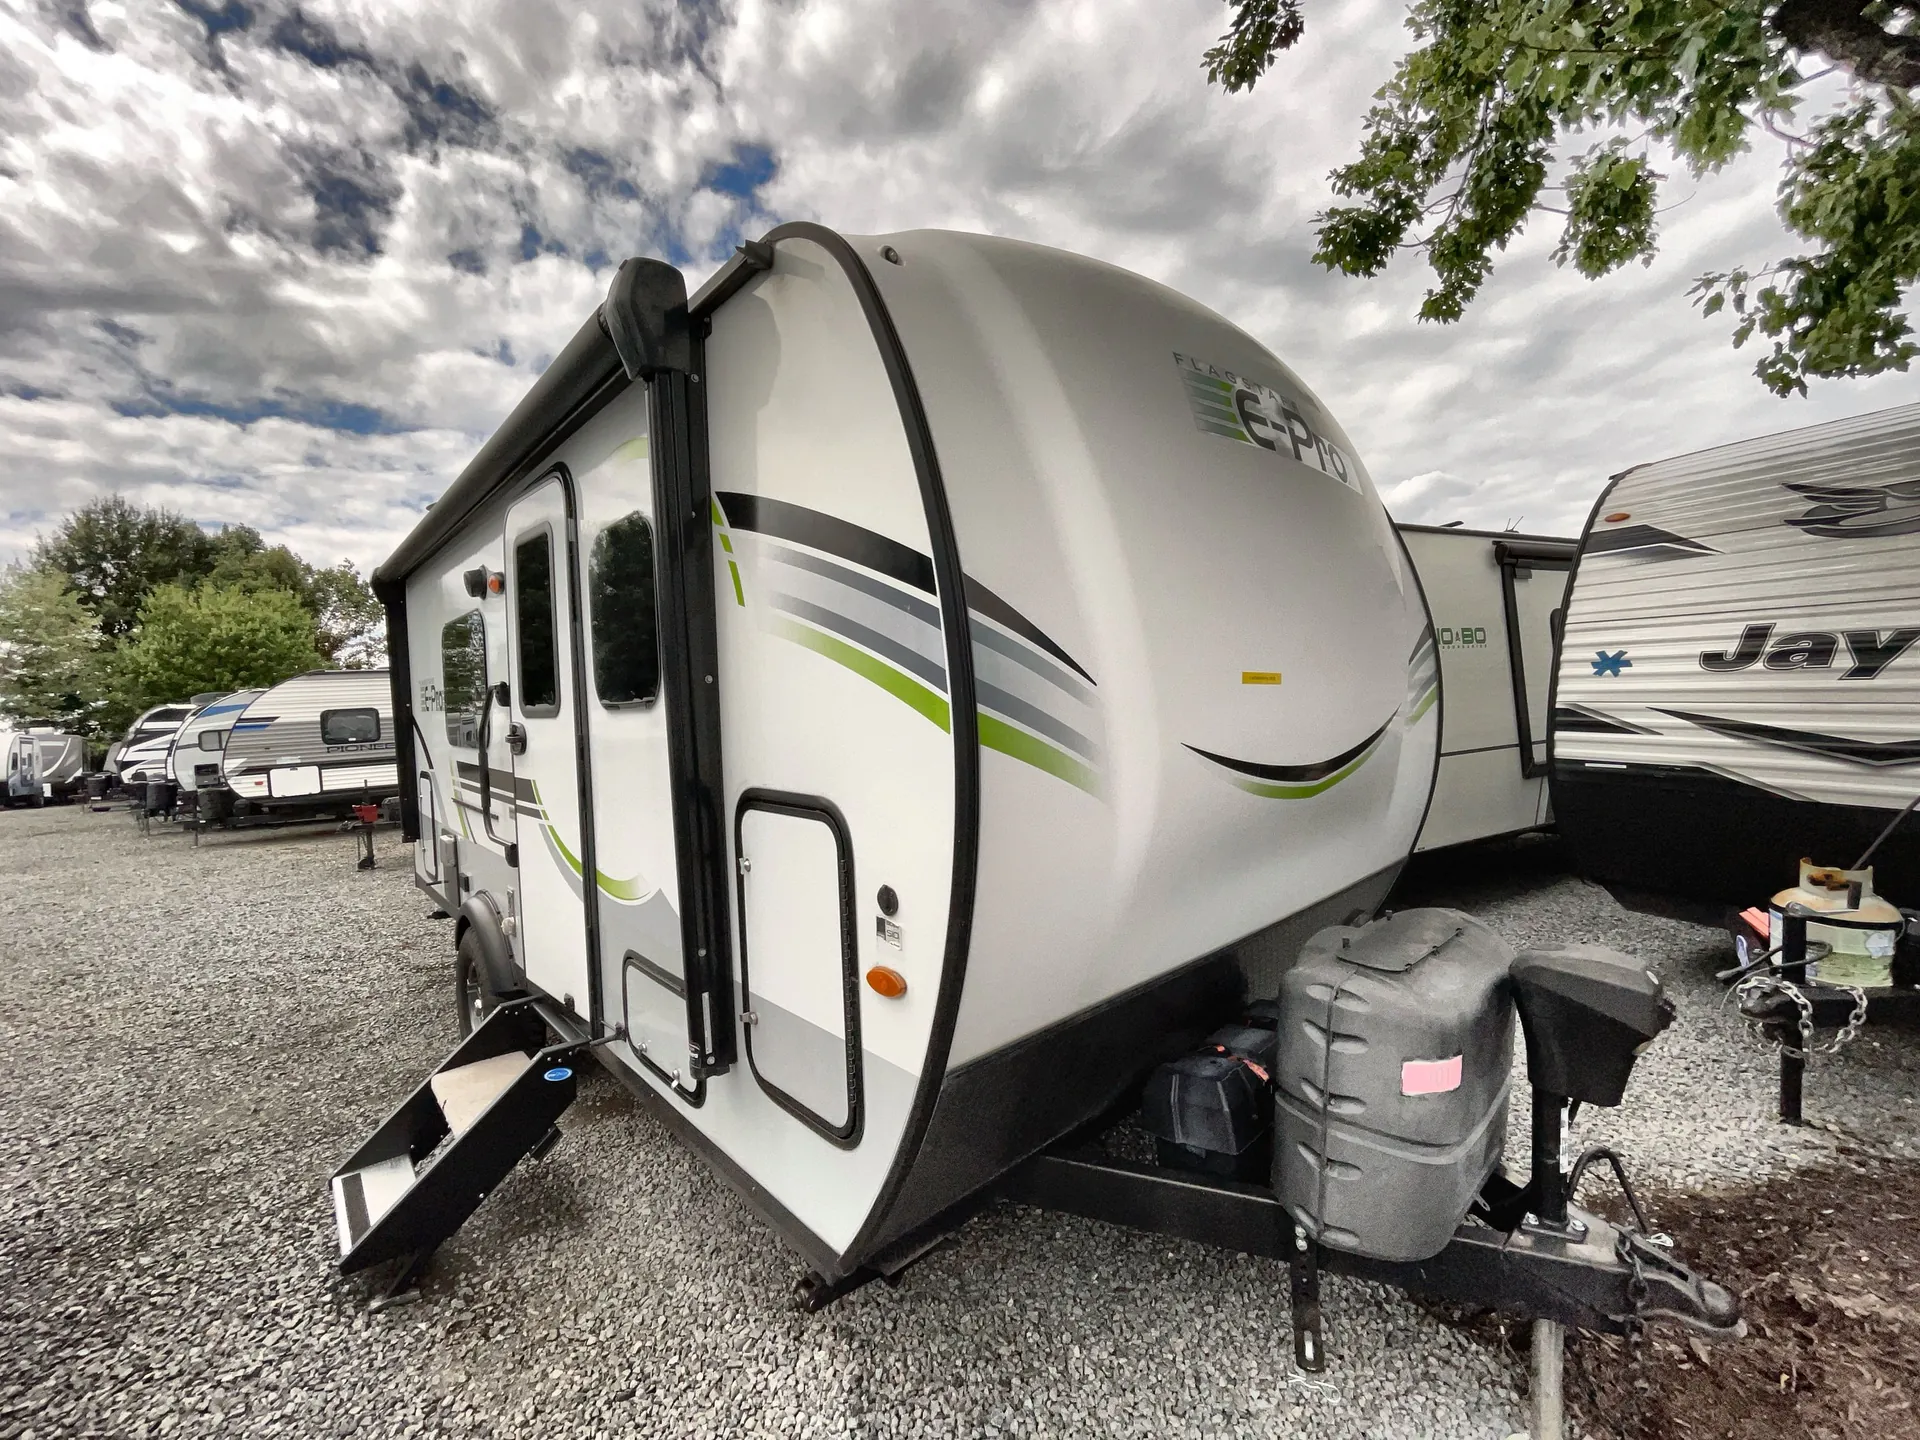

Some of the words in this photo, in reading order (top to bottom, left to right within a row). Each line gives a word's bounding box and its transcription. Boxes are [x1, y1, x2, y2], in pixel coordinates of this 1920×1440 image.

[1172, 351, 1298, 410] FLAGSTAFF
[1236, 388, 1348, 483] E-Pro
[1699, 622, 1920, 680] Jay
